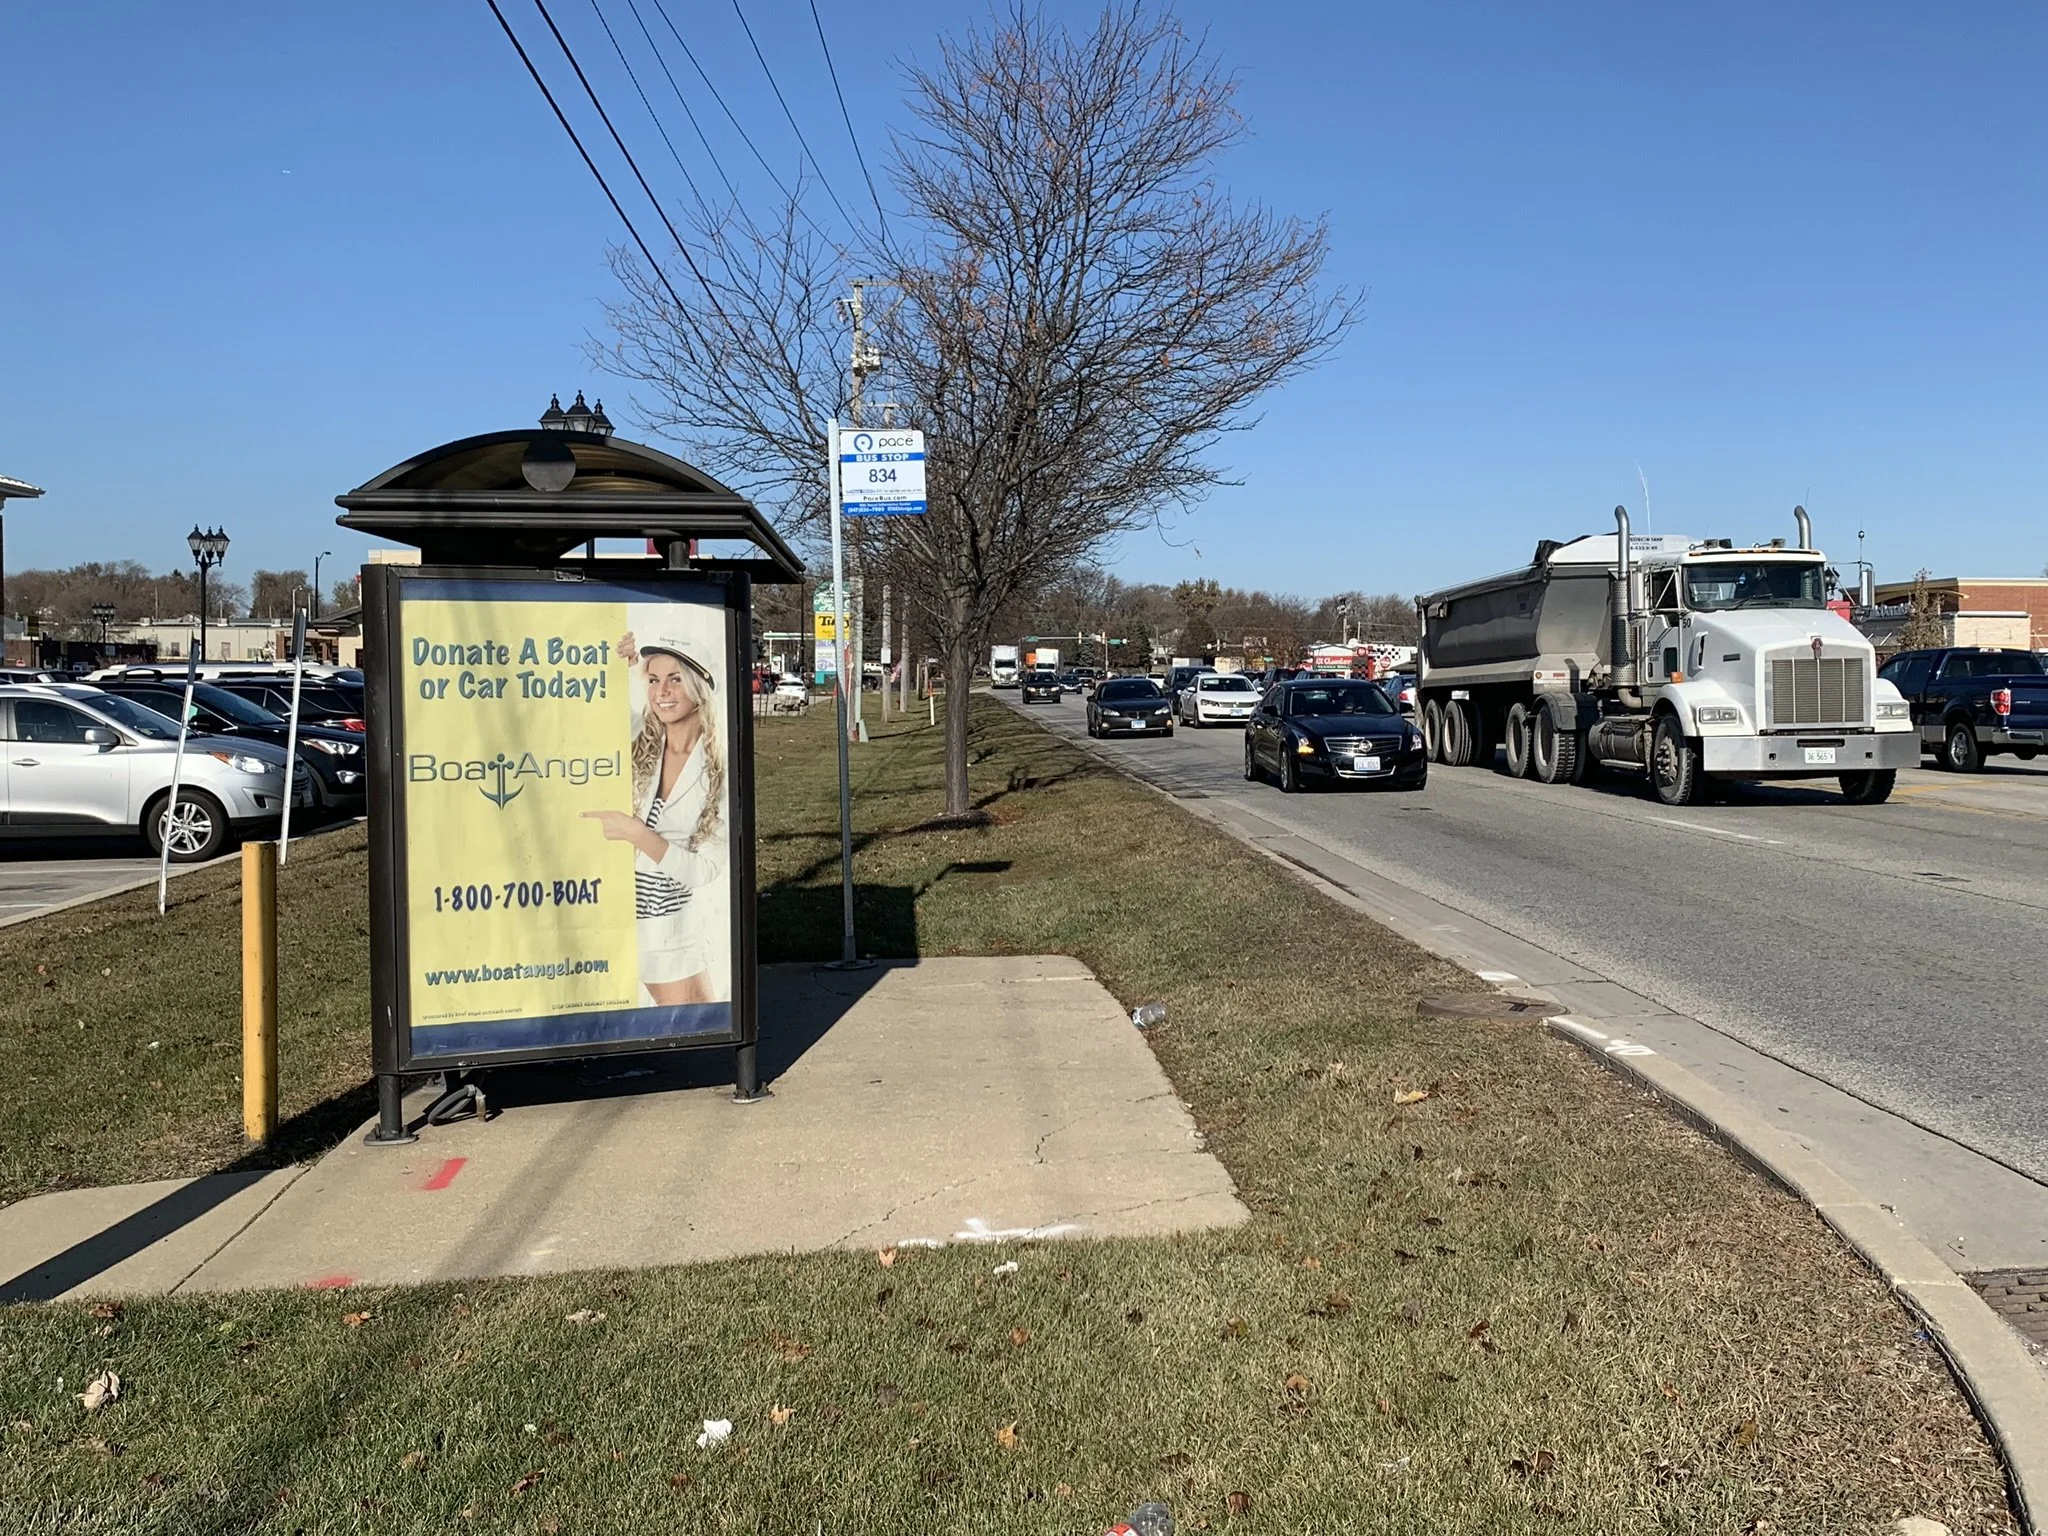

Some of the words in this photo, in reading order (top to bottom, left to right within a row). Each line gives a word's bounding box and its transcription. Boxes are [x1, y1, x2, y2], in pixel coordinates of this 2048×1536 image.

[879, 437, 914, 448] pace
[856, 454, 878, 462] BUS
[881, 453, 909, 461] STOP
[869, 468, 897, 483] 834
[412, 637, 510, 666] Donate
[519, 638, 541, 665] A
[548, 636, 611, 666] Boat
[420, 678, 450, 700] or
[458, 672, 508, 700] Car
[517, 670, 607, 702] Today!
[434, 878, 602, 912] 1-800-700-BOAT
[425, 957, 609, 986] www.boatangel.com
